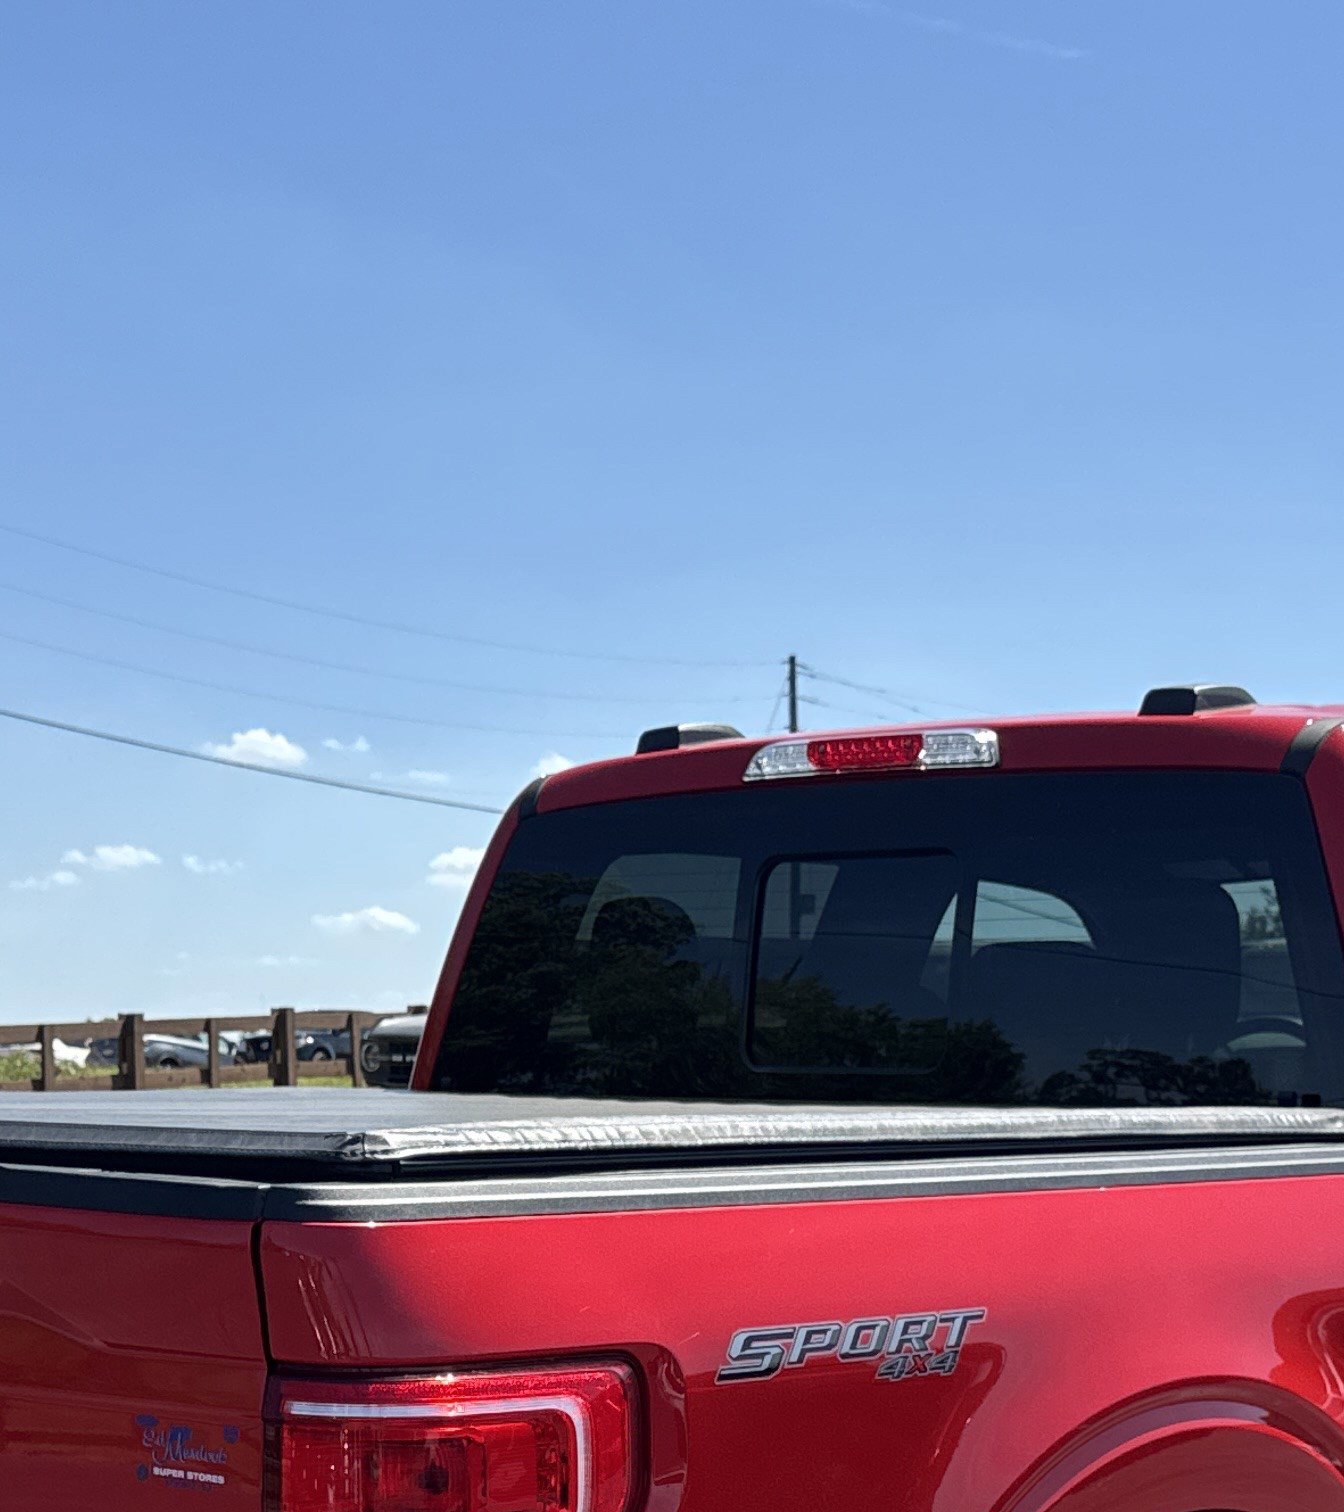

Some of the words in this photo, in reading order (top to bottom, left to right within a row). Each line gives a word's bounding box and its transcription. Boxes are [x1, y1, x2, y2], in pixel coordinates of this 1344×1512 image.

[714, 1307, 987, 1385] SPORT
[153, 1466, 185, 1478] SUPER
[186, 1471, 226, 1485] STORES
